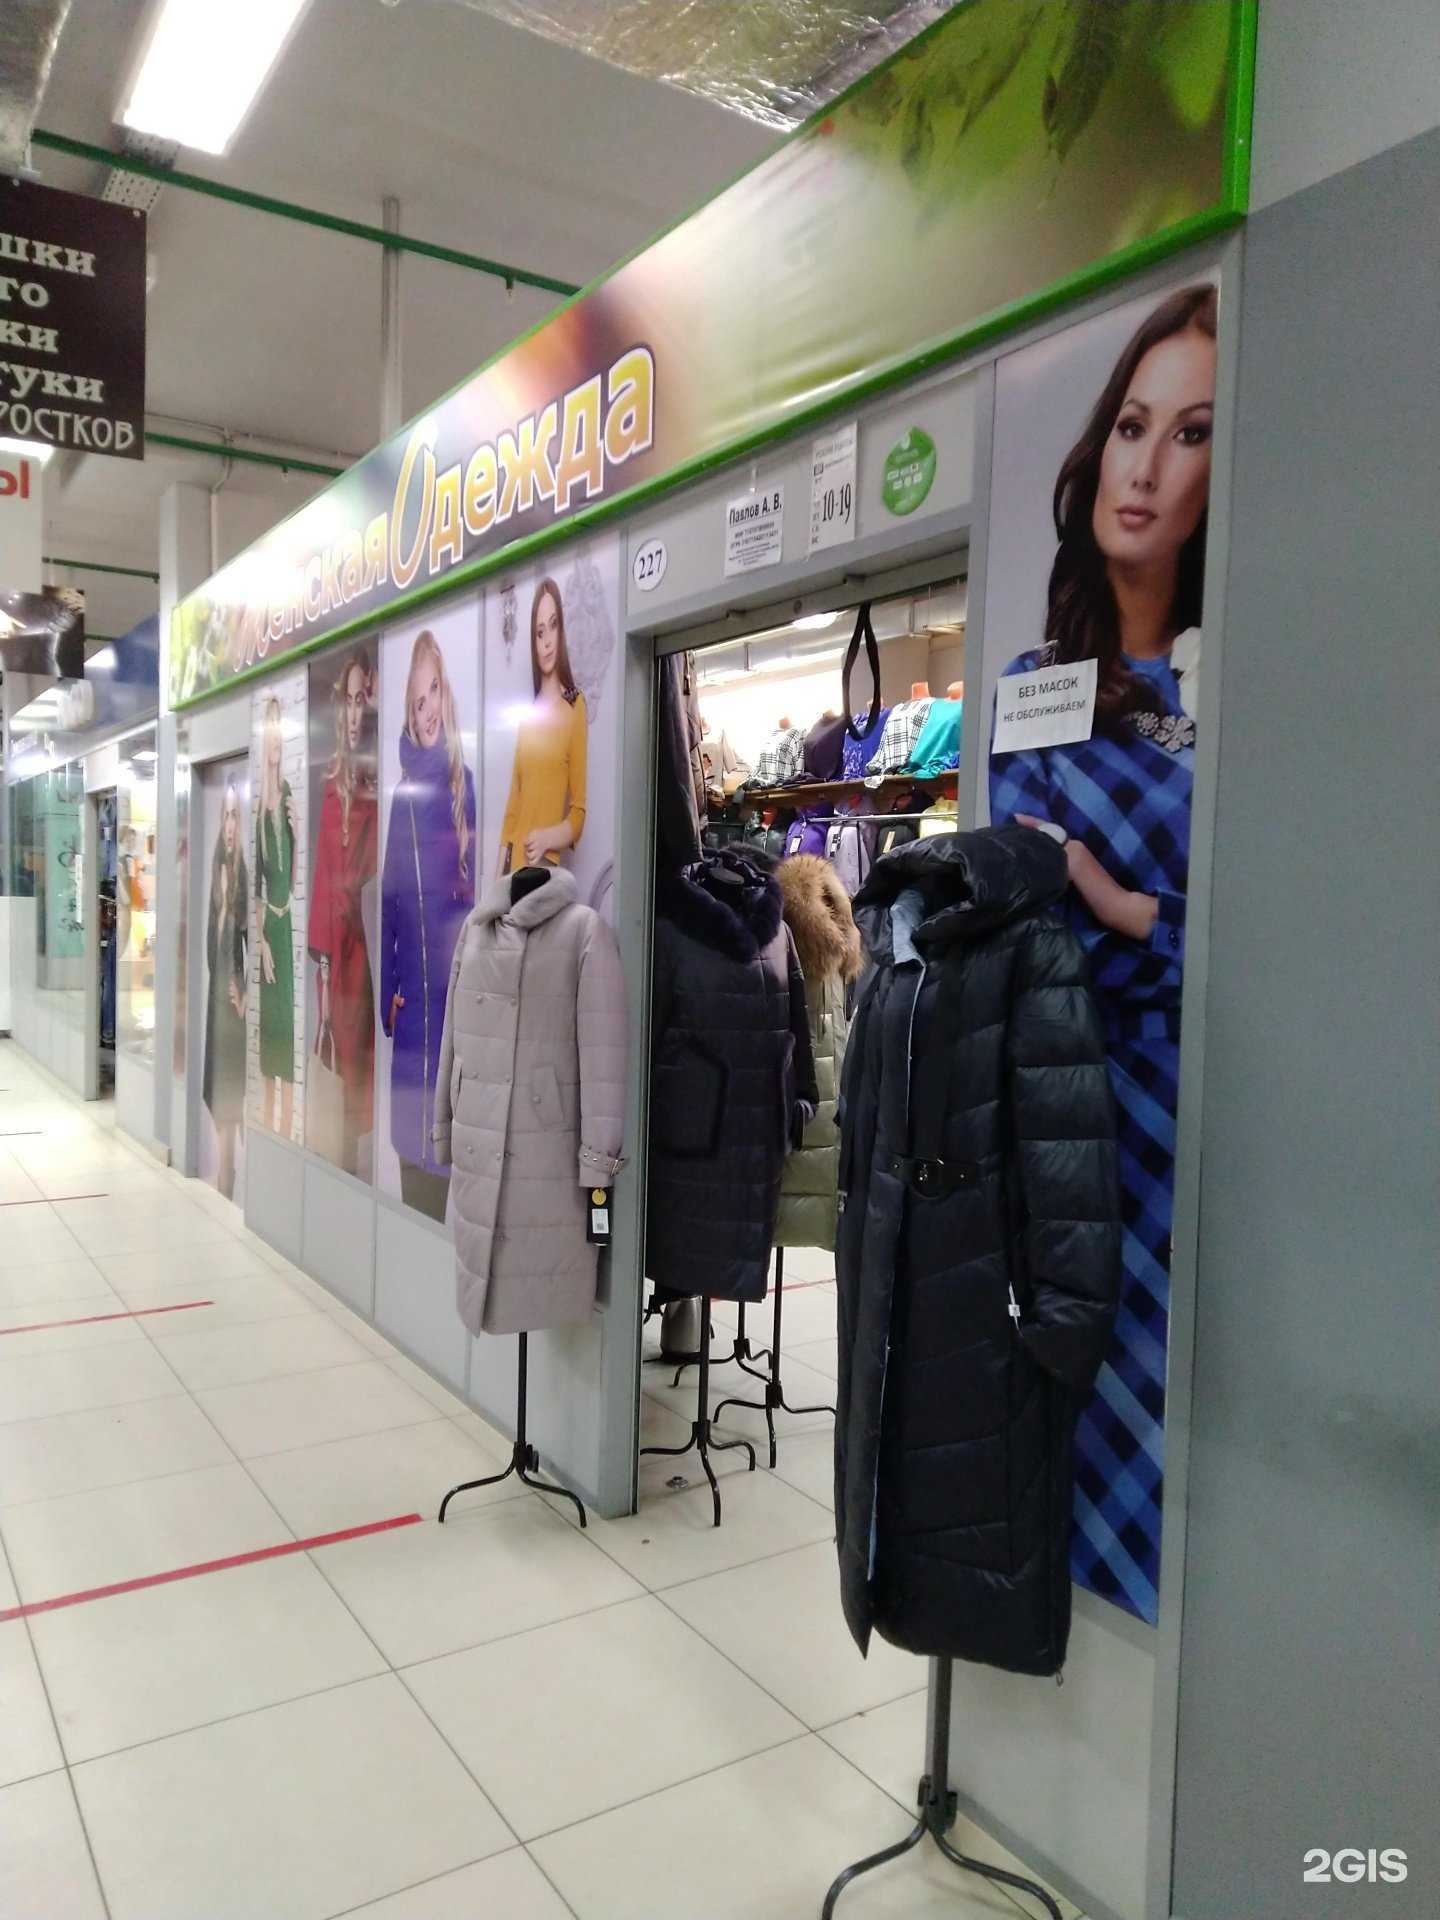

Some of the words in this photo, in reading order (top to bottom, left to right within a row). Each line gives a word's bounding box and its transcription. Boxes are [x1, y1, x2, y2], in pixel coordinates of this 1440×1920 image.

[390, 347, 655, 589] Одежда
[729, 503, 760, 527] Павлов
[762, 496, 771, 513] А.
[773, 492, 783, 511] В.
[822, 482, 852, 525] 10-19
[638, 549, 663, 580] 227
[1018, 684, 1037, 699] БЕЗ
[1039, 676, 1079, 695] МАСОК
[1003, 710, 1015, 723] НЕ
[1016, 699, 1086, 721] ОБСЛУЖИВАЕМ
